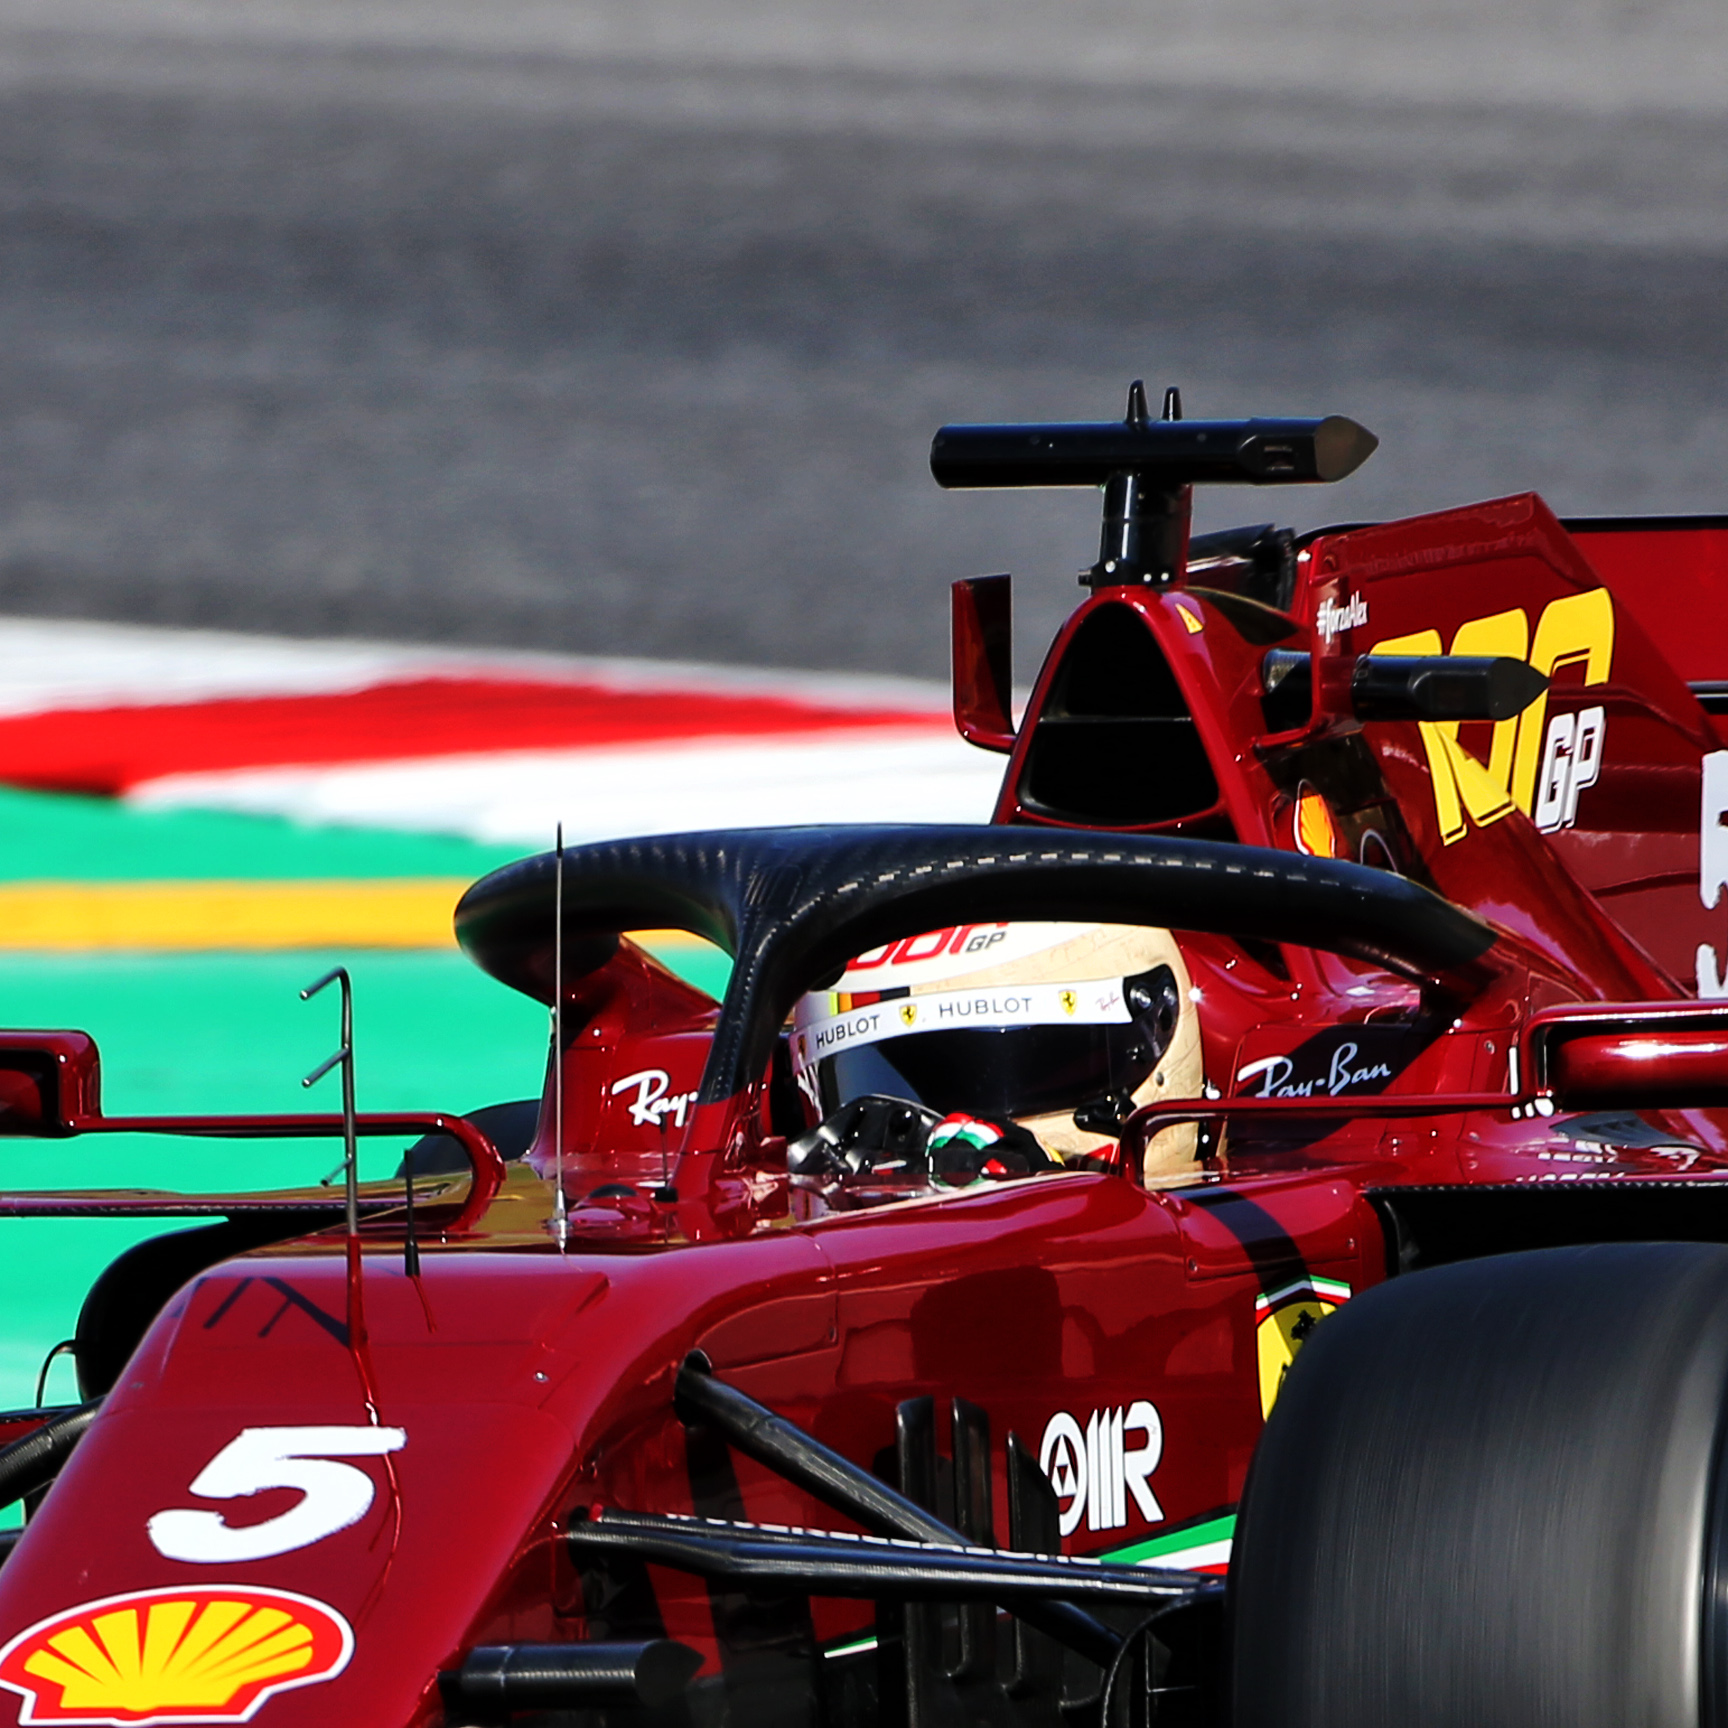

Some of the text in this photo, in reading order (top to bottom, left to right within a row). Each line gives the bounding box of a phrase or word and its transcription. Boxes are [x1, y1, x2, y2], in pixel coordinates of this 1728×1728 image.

[1535, 706, 1607, 836] GP
[965, 930, 1007, 953] GP
[938, 997, 1033, 1019] HUBLOT
[815, 1014, 880, 1050] HUBLOT
[148, 1425, 407, 1564] 5
